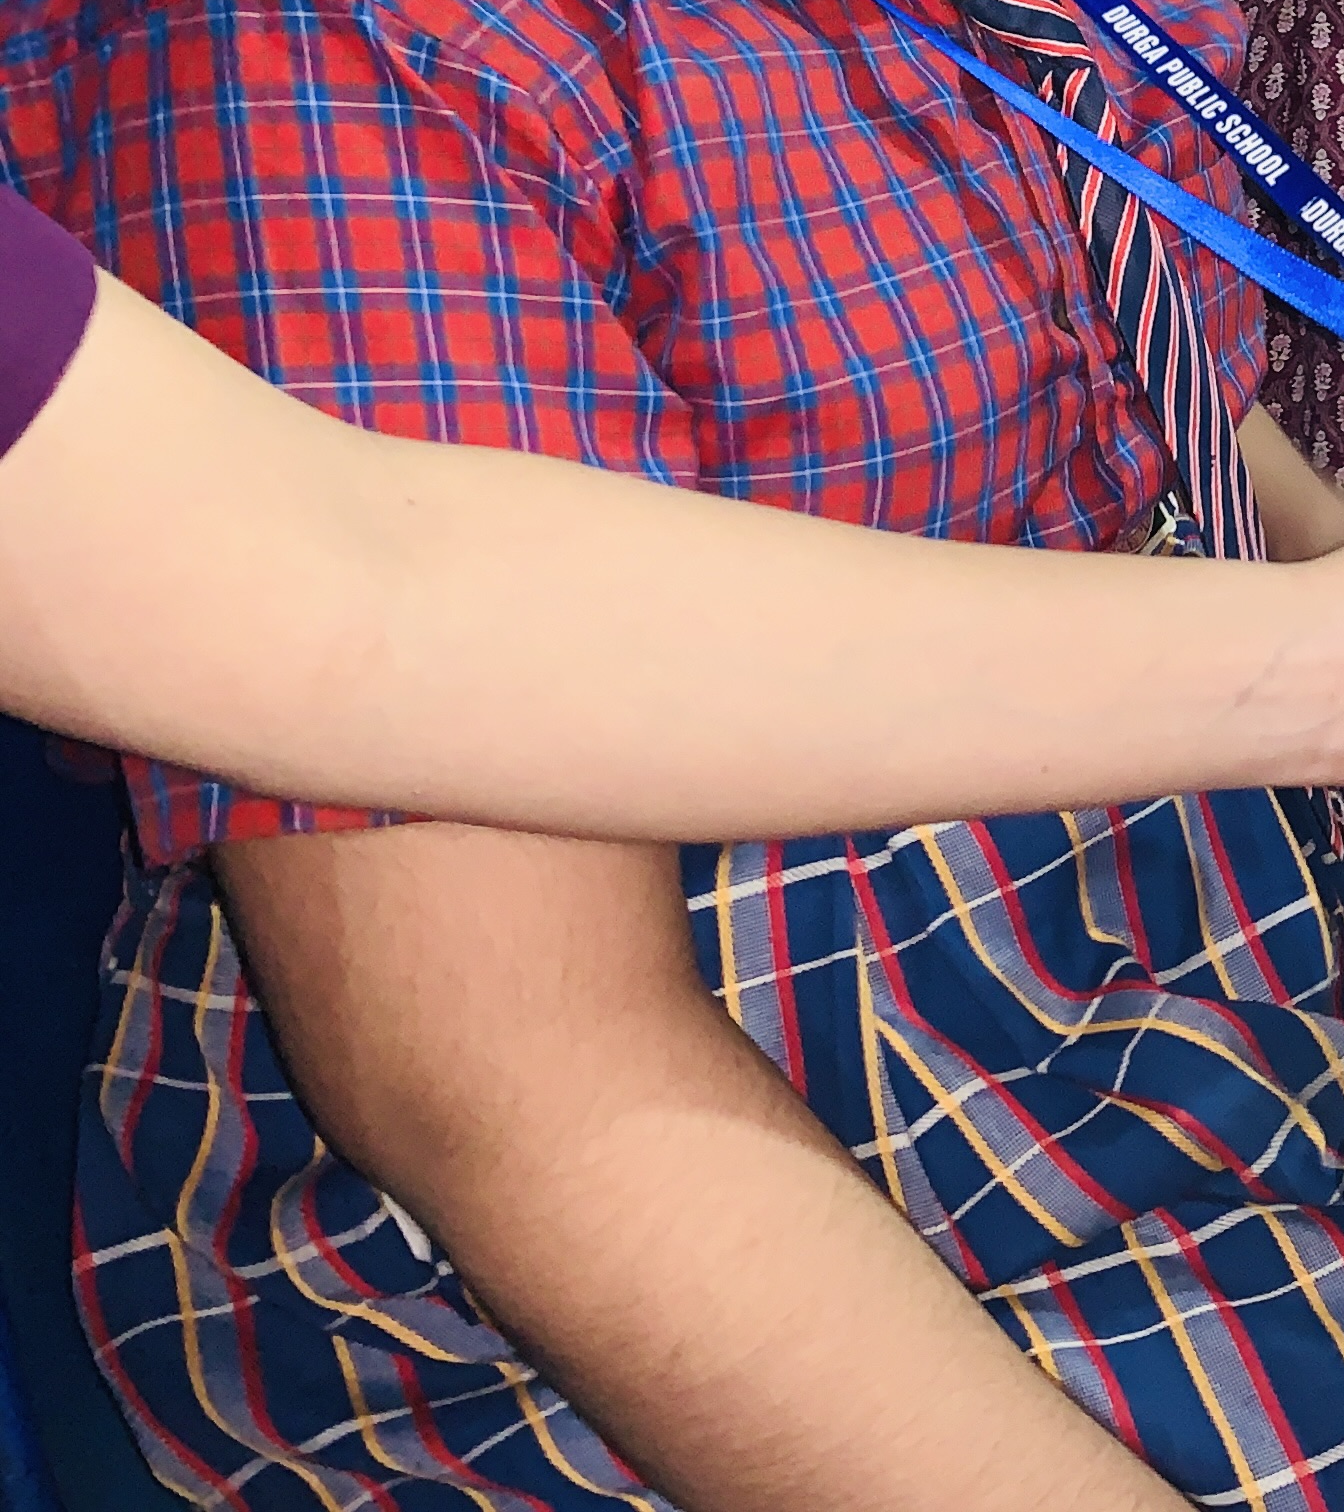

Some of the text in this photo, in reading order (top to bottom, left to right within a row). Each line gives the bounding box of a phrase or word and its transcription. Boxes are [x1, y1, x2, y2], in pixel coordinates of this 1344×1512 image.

[1101, 4, 1291, 187] DURGA PUBLIC SCHOOL
